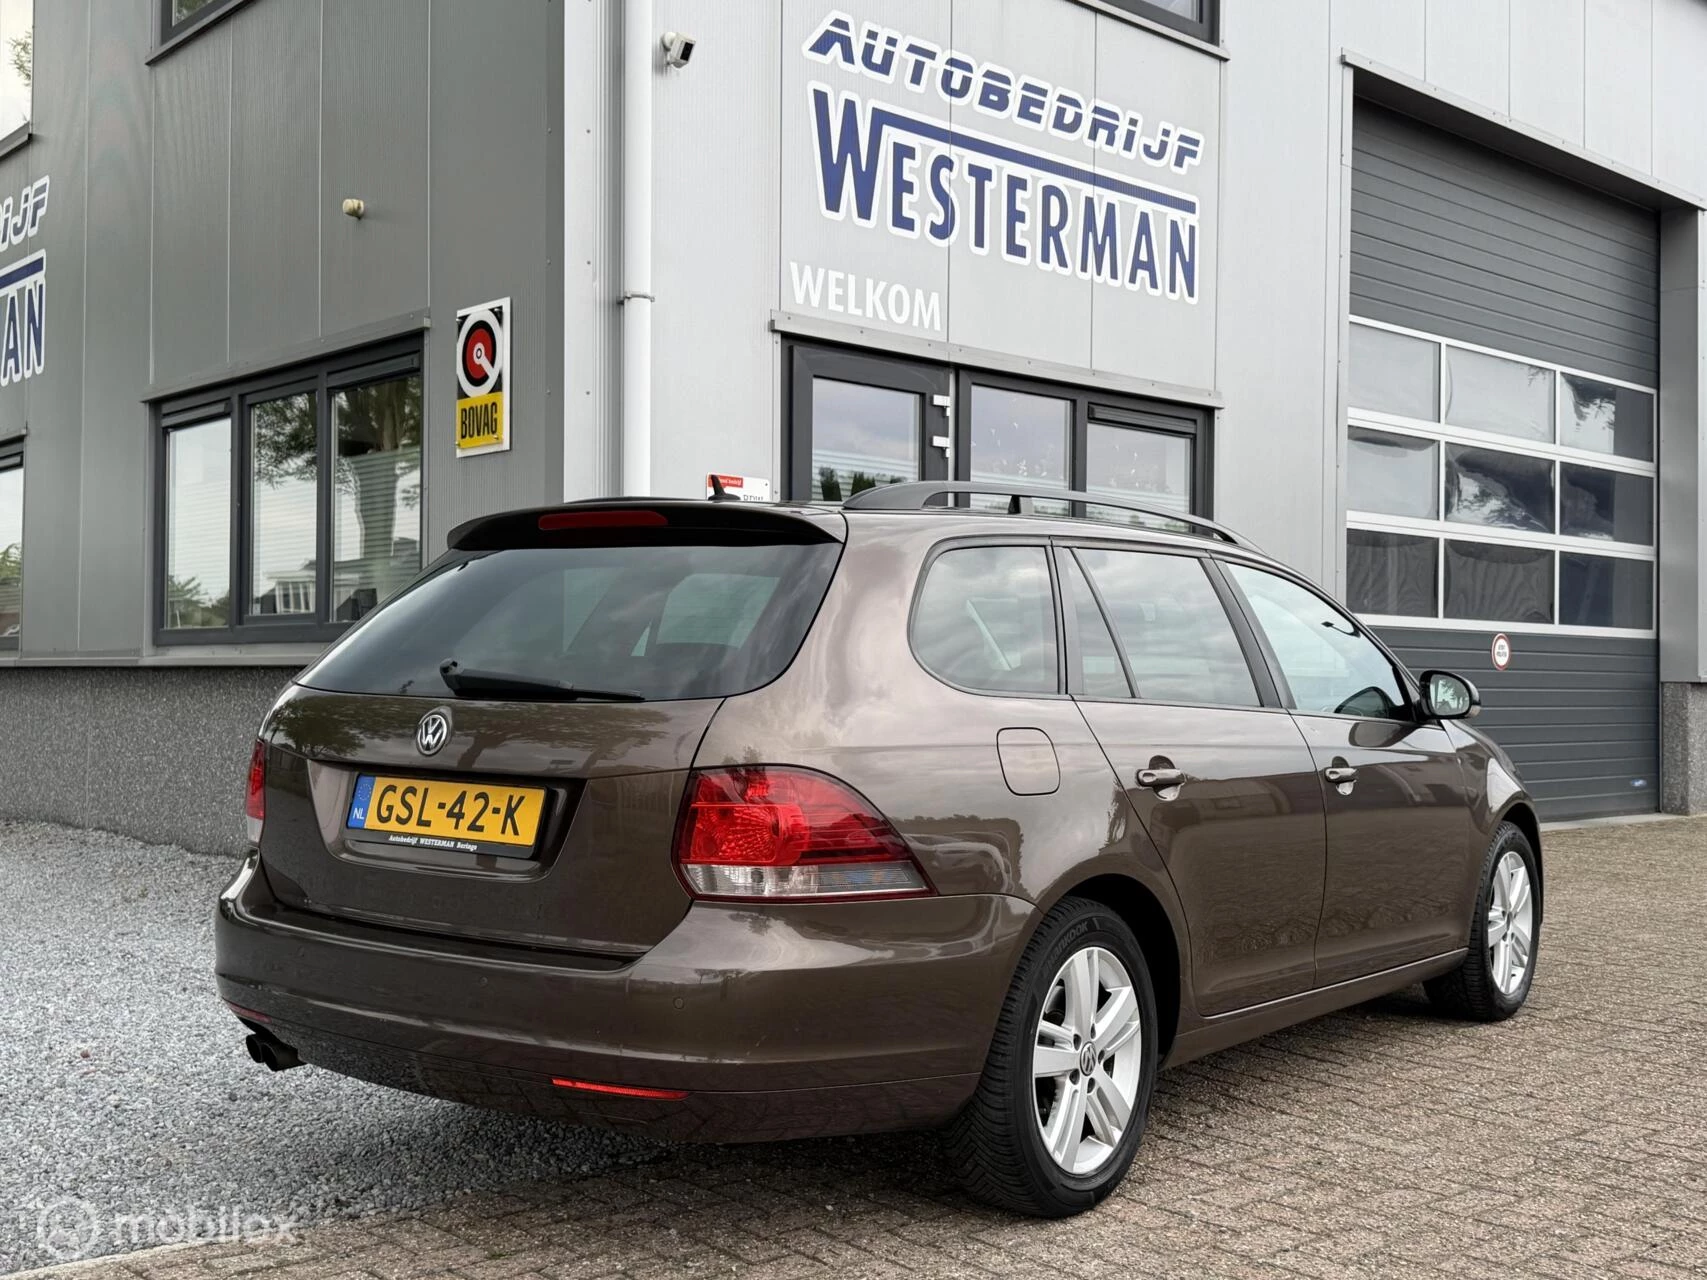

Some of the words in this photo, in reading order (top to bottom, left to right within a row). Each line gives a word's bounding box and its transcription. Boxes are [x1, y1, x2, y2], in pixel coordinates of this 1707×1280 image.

[811, 86, 1199, 301] WESTERMAN
[790, 262, 941, 331] WELKOM
[460, 401, 498, 440] BOVAG
[353, 807, 364, 819] NL
[376, 784, 526, 836] GSL-42-K
[419, 837, 455, 848] WESTERMAN
